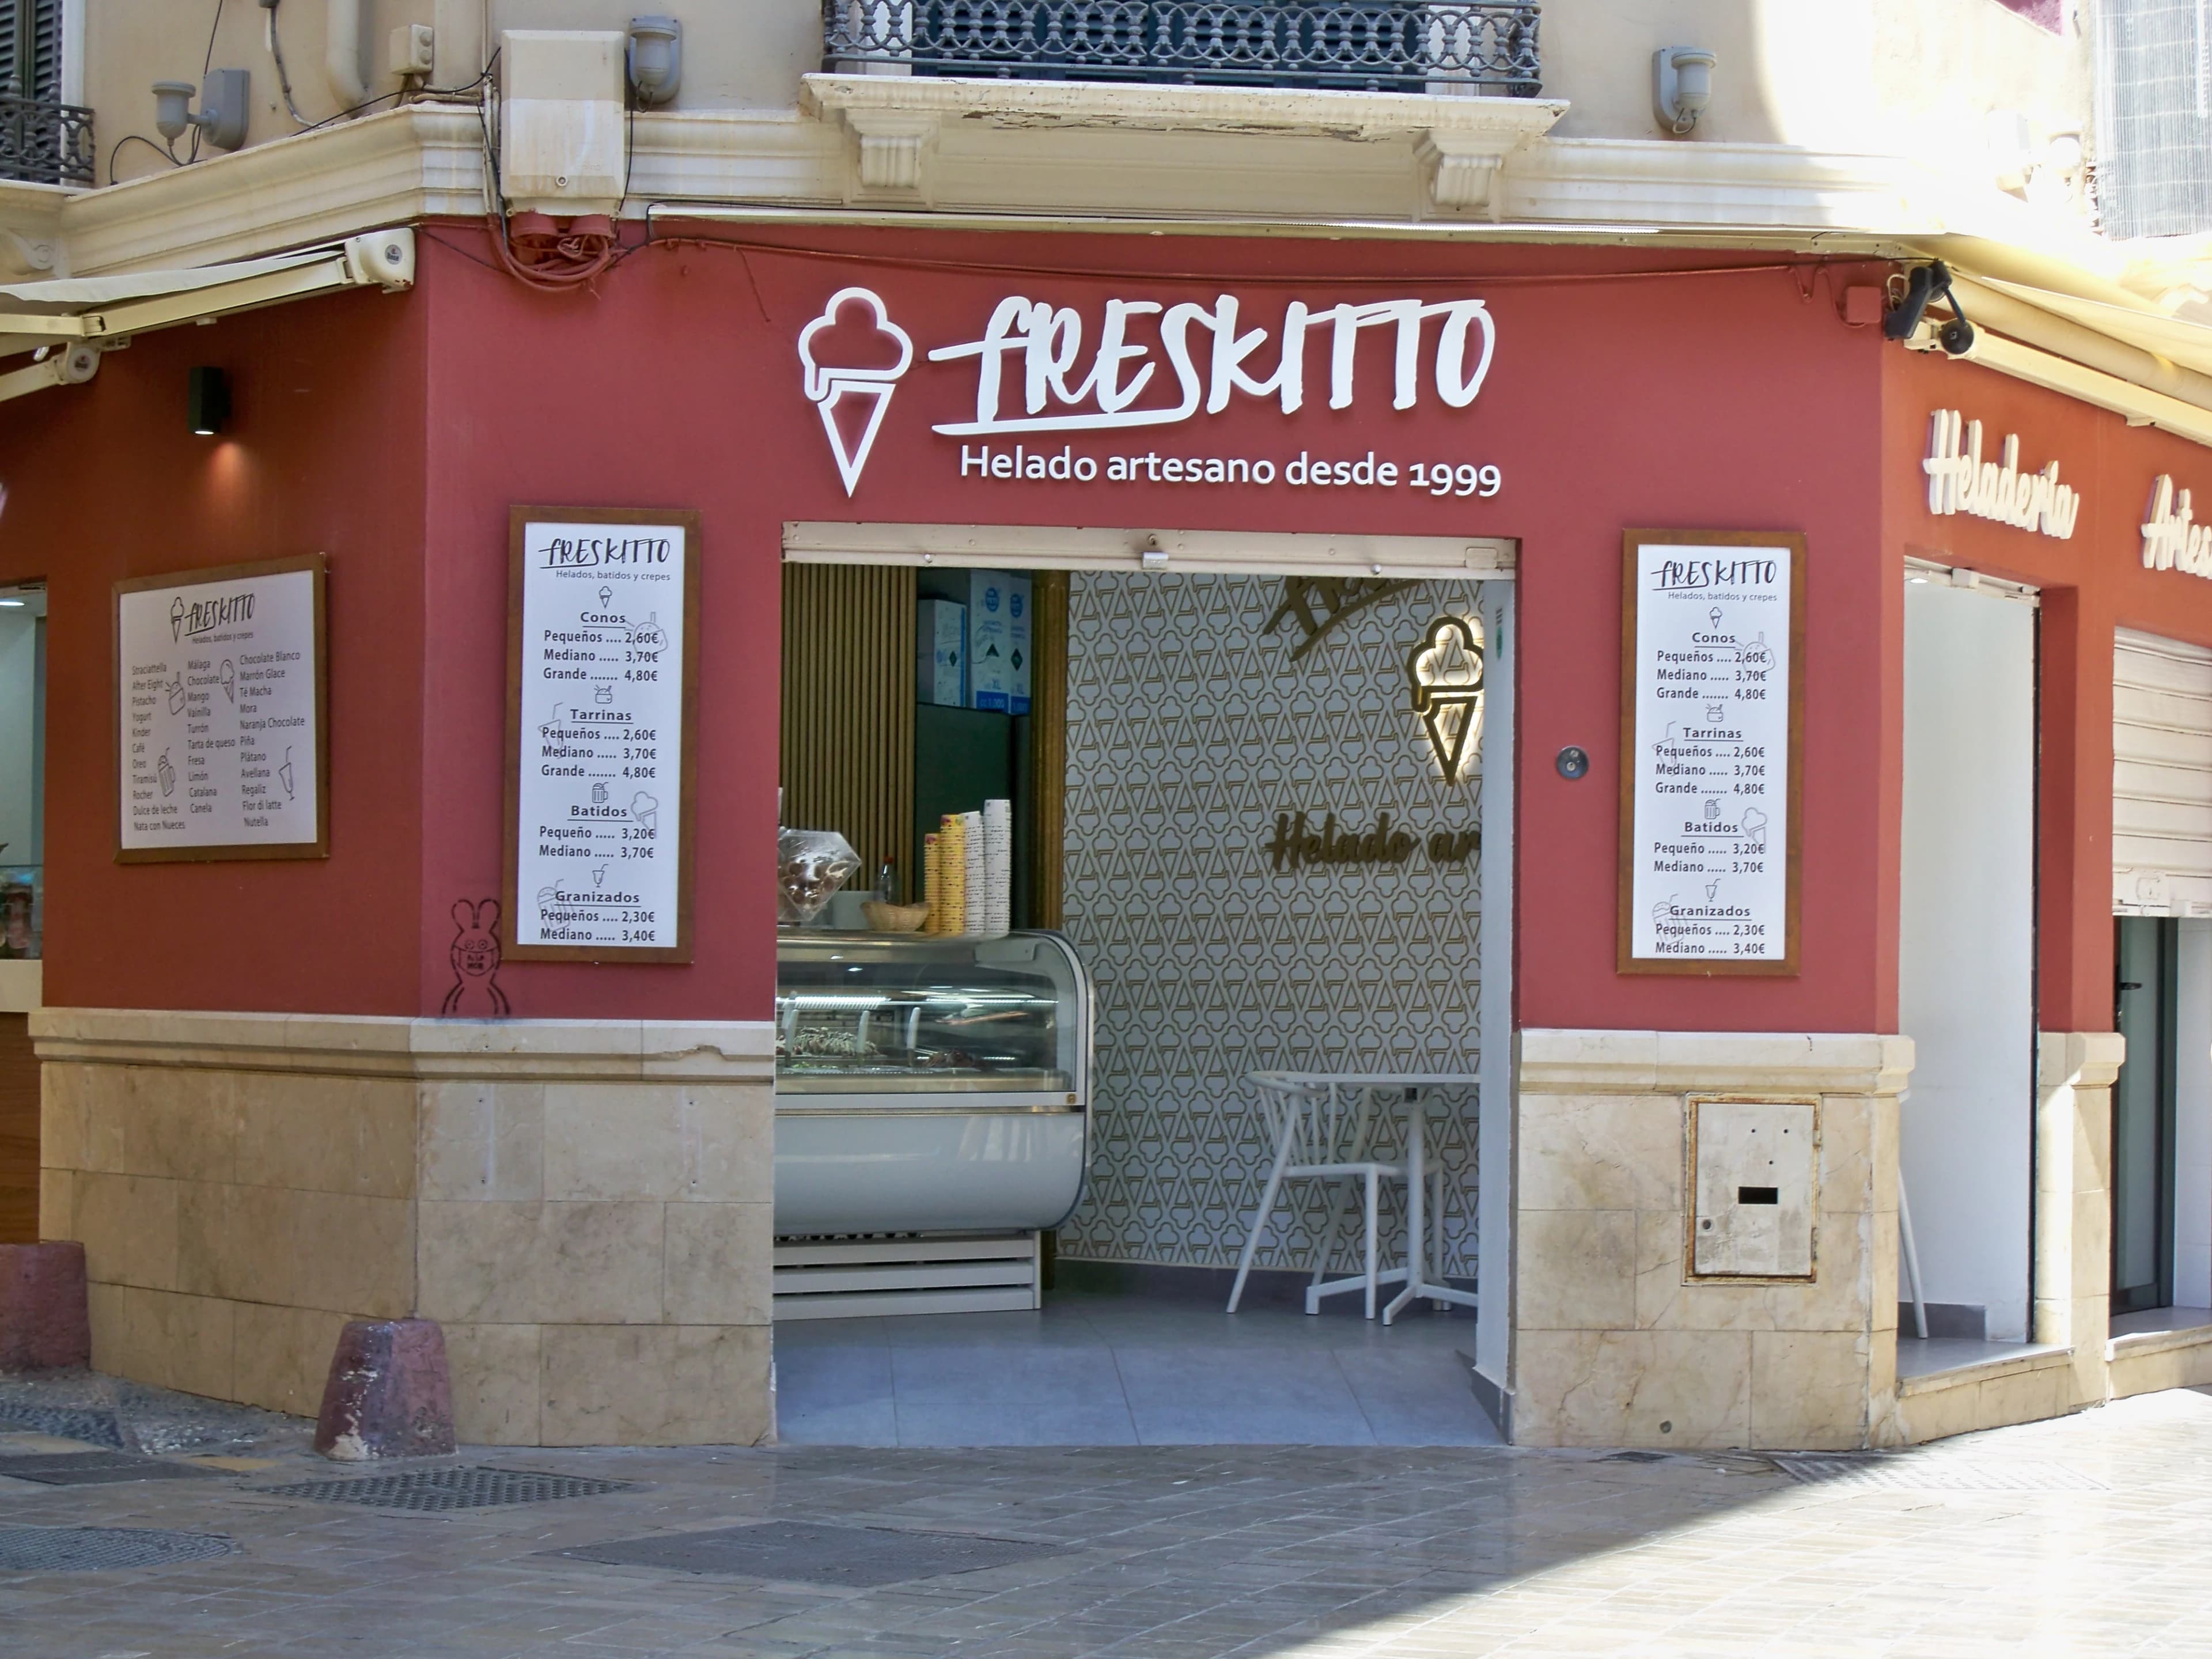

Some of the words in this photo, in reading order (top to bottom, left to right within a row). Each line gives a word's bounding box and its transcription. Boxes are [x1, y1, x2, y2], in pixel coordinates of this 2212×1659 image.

[961, 446, 1098, 482] Helado
[1107, 449, 1276, 484] artesano
[1284, 452, 1397, 487] desde
[1410, 463, 1501, 498] 1999
[556, 570, 594, 579] Helados,
[597, 571, 631, 579] batidos
[641, 573, 671, 581] crepes
[1668, 592, 1705, 601] Helados,
[1707, 592, 1739, 601] batidos
[1749, 593, 1777, 602] crepes
[581, 612, 626, 623] Conos
[544, 630, 603, 643] Pequeños
[625, 633, 659, 645] 2,60€
[1692, 632, 1736, 643] Conos
[240, 653, 274, 665] Chocolate
[276, 650, 300, 662] Blanco
[544, 649, 596, 661] Mediano
[626, 652, 659, 663] 3,70€
[1657, 650, 1713, 664] Pequeños
[1734, 652, 1766, 664] 2,60€
[266, 668, 286, 679] Glace
[543, 668, 587, 679] Grande
[624, 670, 658, 682] 4,80€
[1657, 669, 1707, 680] Mediano
[1735, 671, 1766, 682] 3,70€
[188, 675, 219, 685] Chocolate
[249, 685, 272, 696] Macha
[1657, 687, 1699, 699] Grande
[1734, 689, 1766, 700] 4,80€
[132, 695, 157, 705] Pistacho
[188, 692, 209, 703] Mango
[187, 707, 210, 717] Vainilla
[240, 704, 257, 713] Mora
[570, 709, 632, 721] Tarrinas
[240, 719, 266, 731] Naranja
[267, 715, 305, 728] Chocolate
[132, 728, 151, 737] Kinder
[542, 727, 601, 739] Pequeños
[623, 729, 657, 741] 2,60€
[1683, 728, 1742, 738] Tarrinas
[188, 740, 203, 749] Tarta
[205, 738, 214, 748] de
[215, 737, 235, 749] queso
[240, 735, 255, 746] Piña
[240, 752, 266, 762] Plátano
[541, 745, 594, 758] Mediano
[623, 748, 656, 760] 3,70€
[1656, 745, 1713, 759] Pequeños
[1733, 747, 1765, 758] 2,60€
[132, 759, 146, 768] Oreo
[188, 755, 205, 765] Fresa
[241, 767, 270, 778] Avellana
[541, 764, 585, 777] Grande
[623, 767, 656, 779] 4,80€
[1656, 764, 1706, 775] Mediano
[1734, 766, 1765, 777] 3,70€
[133, 790, 153, 800] Rocher
[189, 786, 217, 797] Catalana
[241, 783, 266, 797] Regaliz
[1656, 782, 1698, 794] Grande
[1733, 783, 1765, 796] 4,80€
[133, 805, 150, 815] Dulce
[151, 805, 159, 814] de
[161, 804, 177, 814] leche
[190, 802, 212, 813] Canela
[243, 801, 256, 810] Flor
[257, 800, 264, 810] di
[266, 799, 282, 809] latte
[571, 805, 628, 817] Batidos
[134, 821, 148, 831] Nata
[162, 821, 185, 830] Nueces
[244, 816, 268, 827] Nutella
[1684, 822, 1738, 833] Batidos
[540, 825, 592, 840] Pequeño
[622, 828, 655, 840] 3,20€
[1264, 811, 1421, 871] Helado
[539, 844, 591, 857] Mediano
[621, 847, 654, 859] 3,70€
[1654, 842, 1705, 856] Pequeño
[1733, 844, 1765, 855] 3,20€
[1654, 860, 1704, 872] Mediano
[1732, 862, 1764, 873] 3,70€
[555, 891, 640, 903] Granizados
[541, 910, 599, 923] Pequeños
[622, 911, 655, 923] 2,30€
[1671, 906, 1751, 916] Granizados
[540, 929, 592, 940] Mediano
[622, 930, 655, 942] 3,40€
[1656, 923, 1712, 937] Pequeños
[1733, 925, 1765, 936] 2,30€
[1656, 942, 1705, 953] Mediano
[1733, 944, 1765, 955] 3,40€
